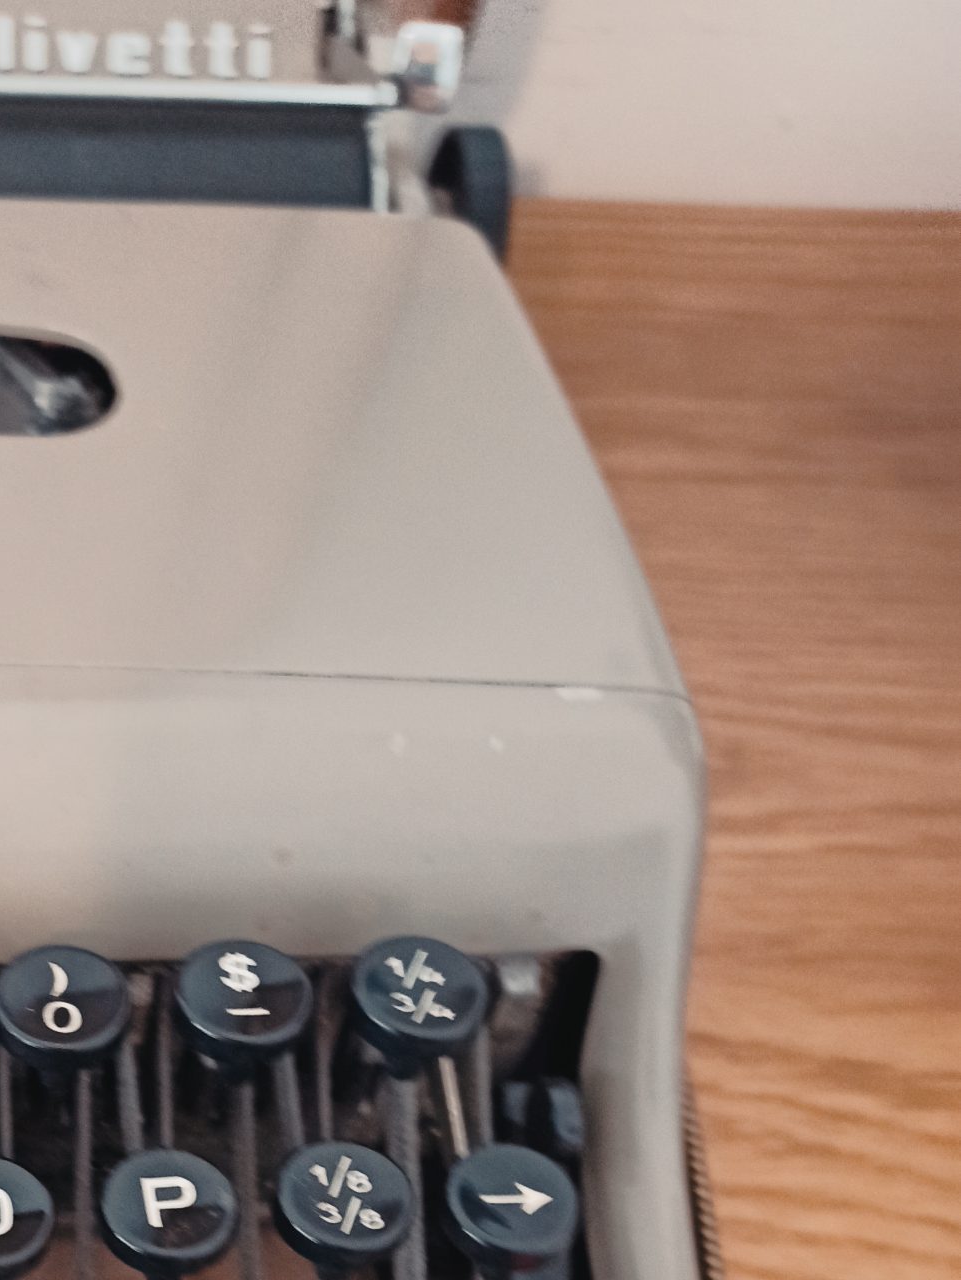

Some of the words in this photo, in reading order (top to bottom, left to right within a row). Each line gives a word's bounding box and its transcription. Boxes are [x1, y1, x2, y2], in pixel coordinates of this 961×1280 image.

[48, 961, 69, 997] )
[218, 951, 260, 993] $
[139, 1175, 197, 1228] P
